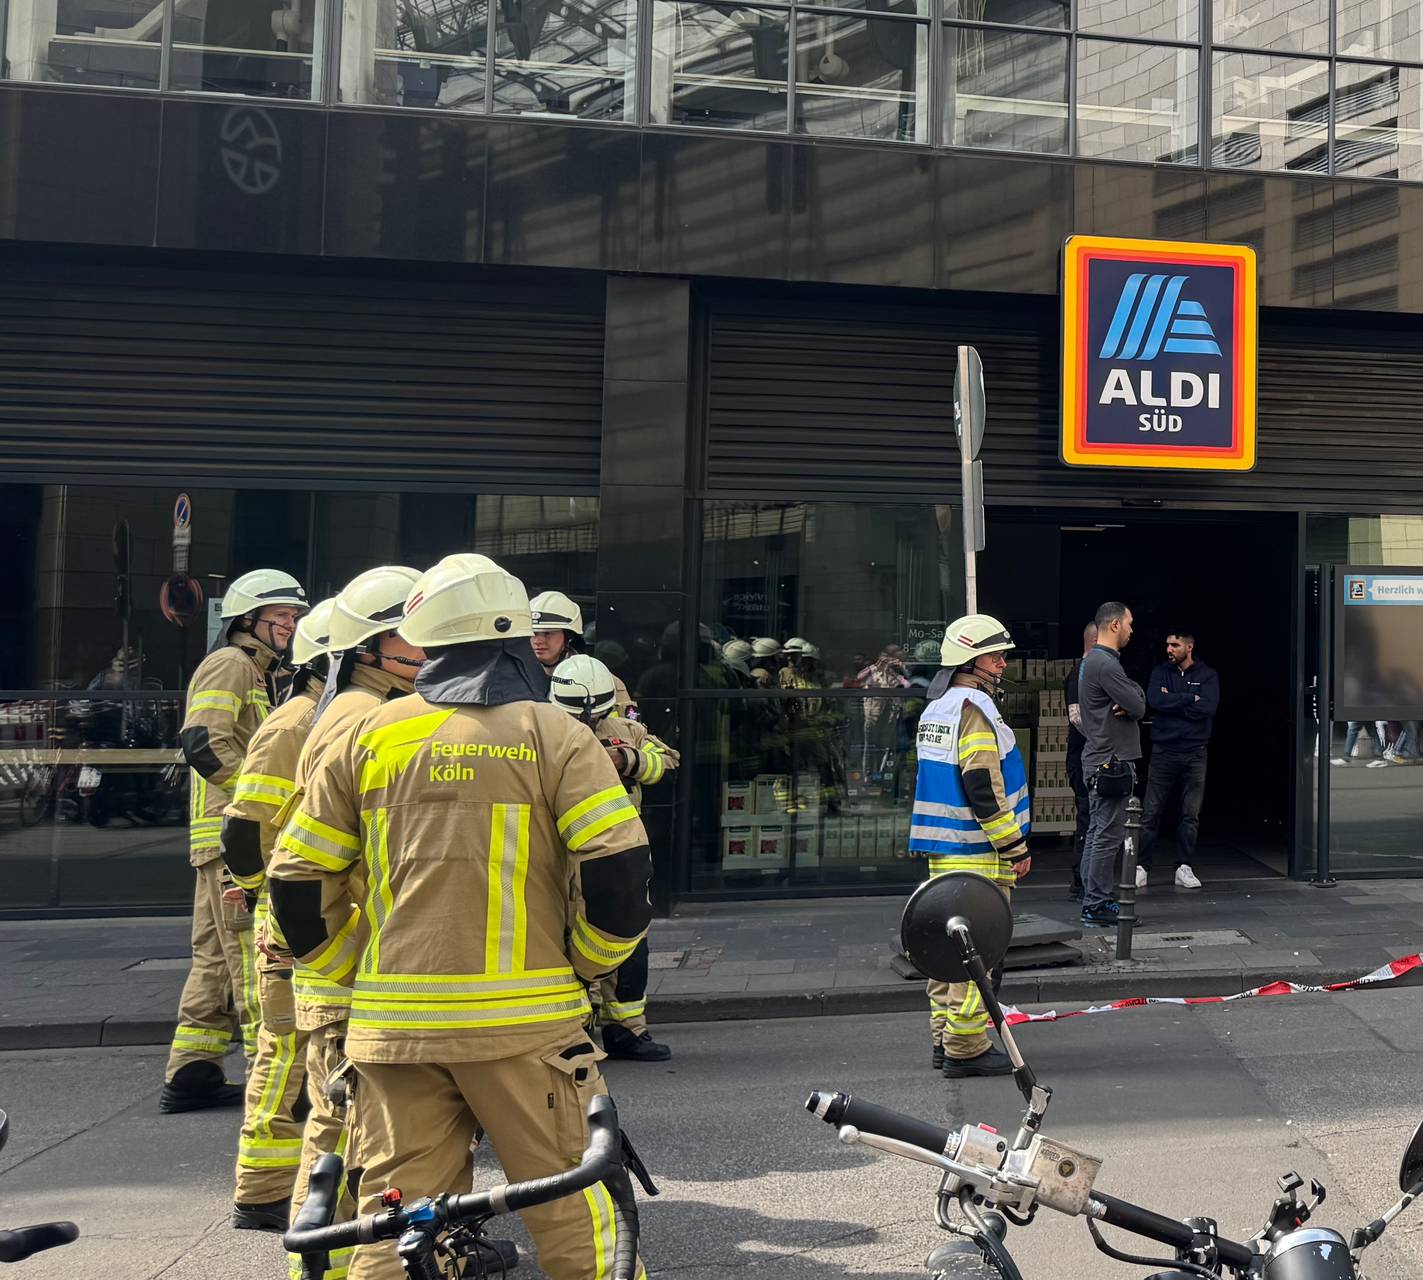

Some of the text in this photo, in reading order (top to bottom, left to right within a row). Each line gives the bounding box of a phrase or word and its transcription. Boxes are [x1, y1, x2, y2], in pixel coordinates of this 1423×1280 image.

[1099, 369, 1220, 409] ALDI
[1138, 409, 1183, 433] SÜD
[1377, 584, 1415, 596] Herzlich
[429, 762, 474, 782] Köln
